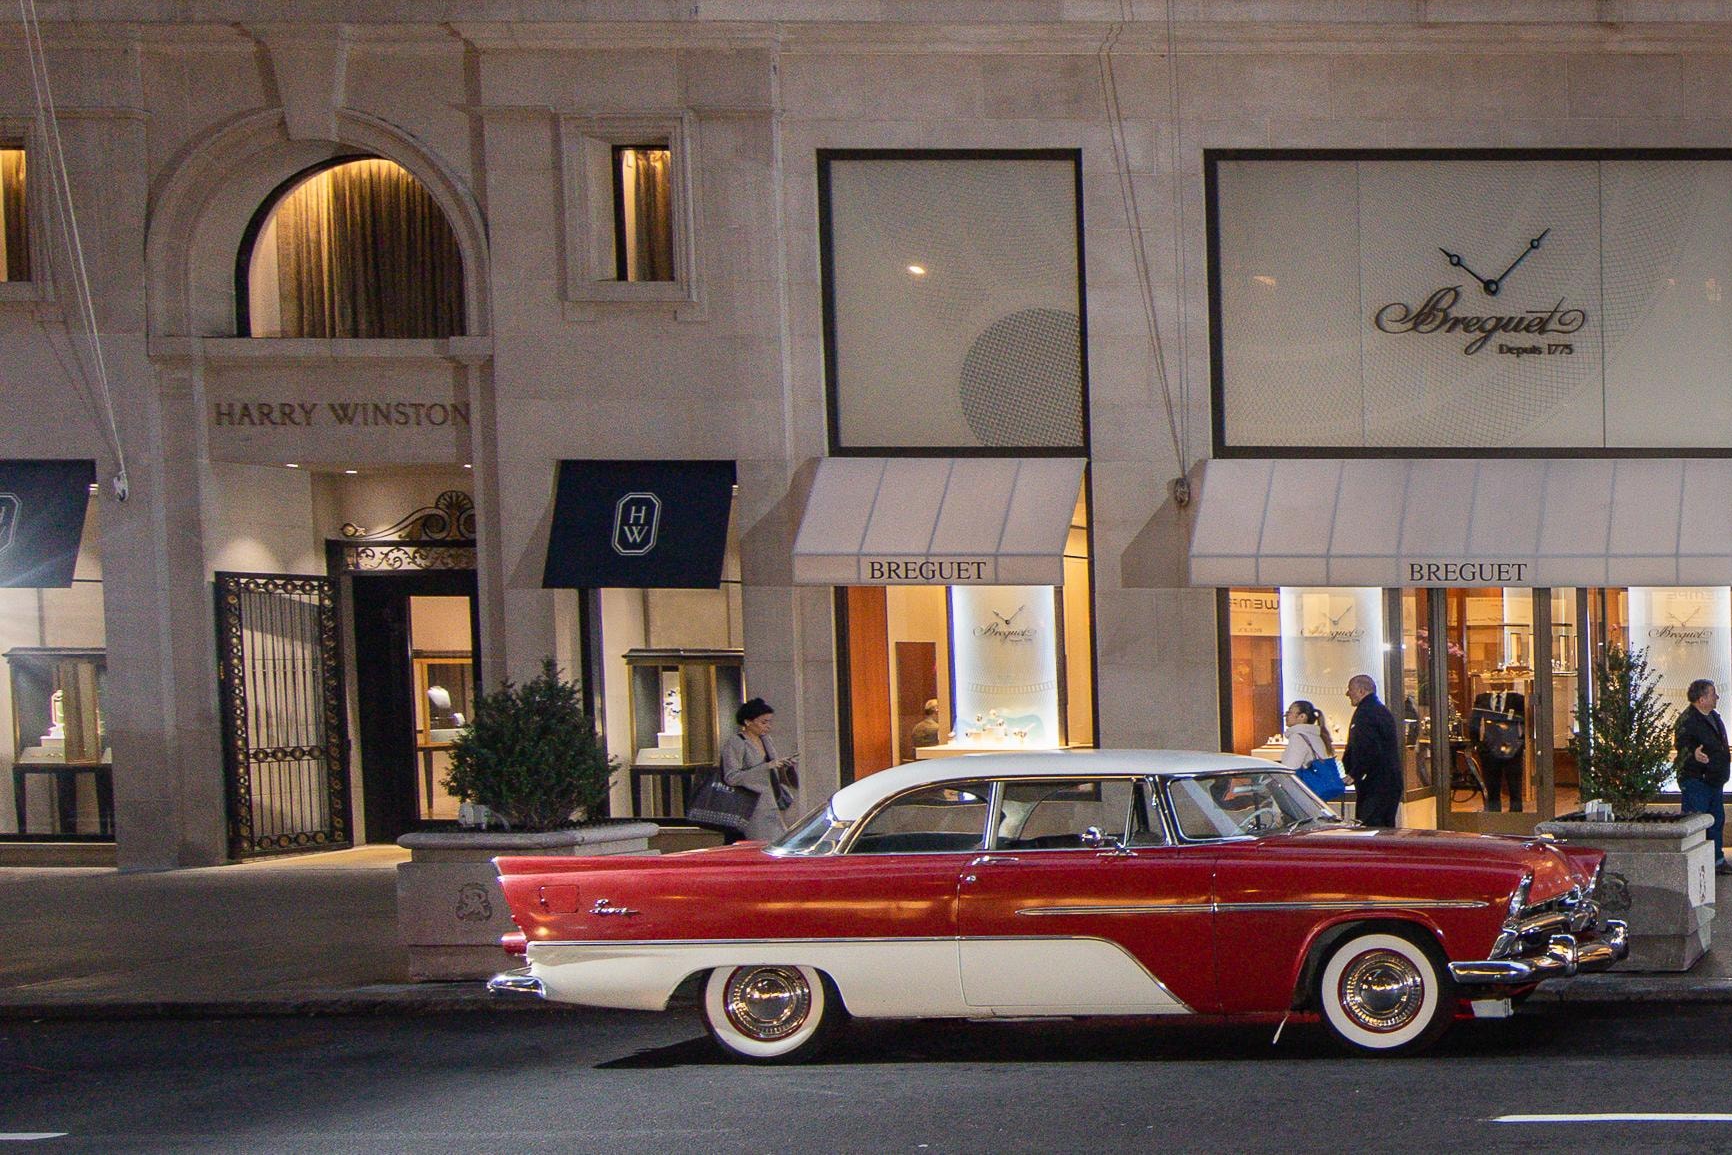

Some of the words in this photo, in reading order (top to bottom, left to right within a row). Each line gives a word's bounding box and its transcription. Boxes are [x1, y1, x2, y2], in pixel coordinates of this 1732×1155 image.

[1374, 284, 1586, 356] Breguet
[1499, 343, 1543, 358] Depuis
[1547, 343, 1574, 356] 1775
[214, 402, 318, 426] HARRY
[327, 402, 472, 426] WINSTON
[629, 505, 647, 524] H
[623, 526, 649, 543] W
[868, 561, 987, 580] BREGUET
[1409, 562, 1528, 582] BREGUET
[973, 622, 1038, 645] Breguet
[1648, 624, 1713, 646] Breguet
